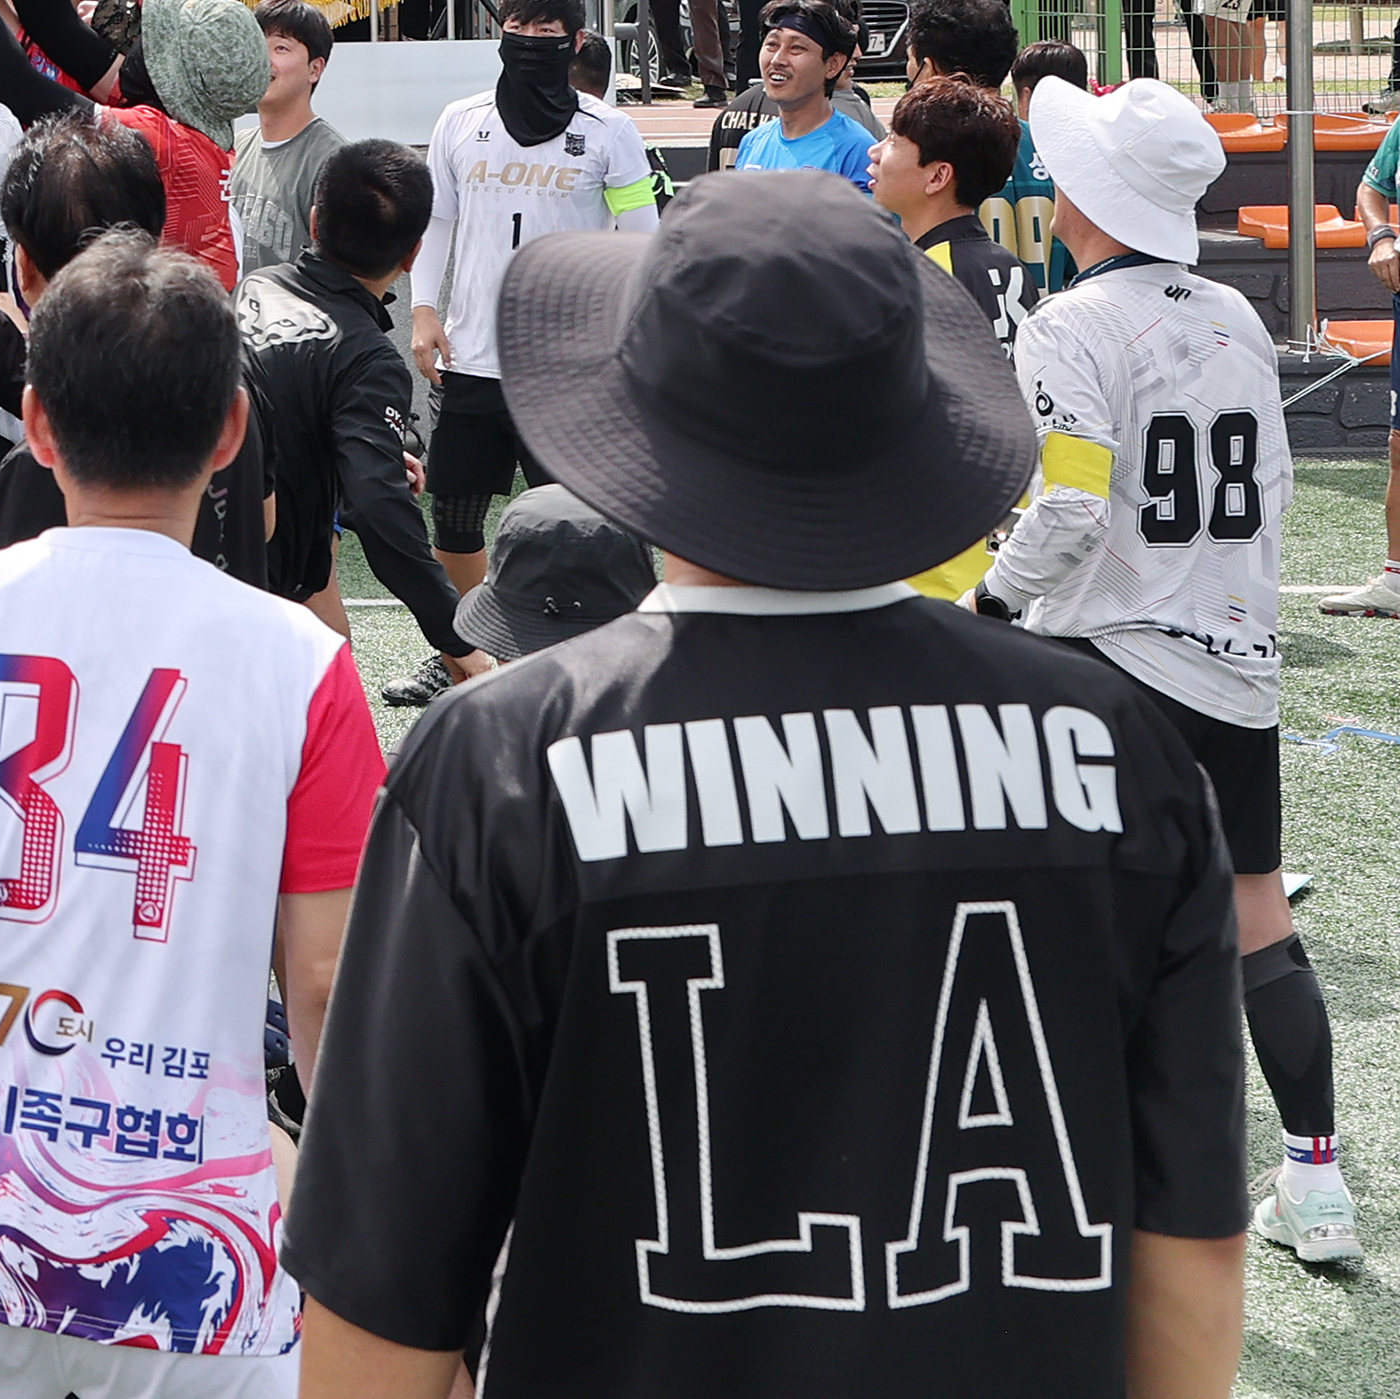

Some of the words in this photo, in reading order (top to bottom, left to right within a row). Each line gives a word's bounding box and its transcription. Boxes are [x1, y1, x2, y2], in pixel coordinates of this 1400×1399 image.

[466, 160, 582, 192] A-ONE
[1137, 407, 1267, 549] 98
[546, 703, 1125, 863] WINNING
[100, 1037, 155, 1076] 우리
[607, 900, 1113, 1313] LA
